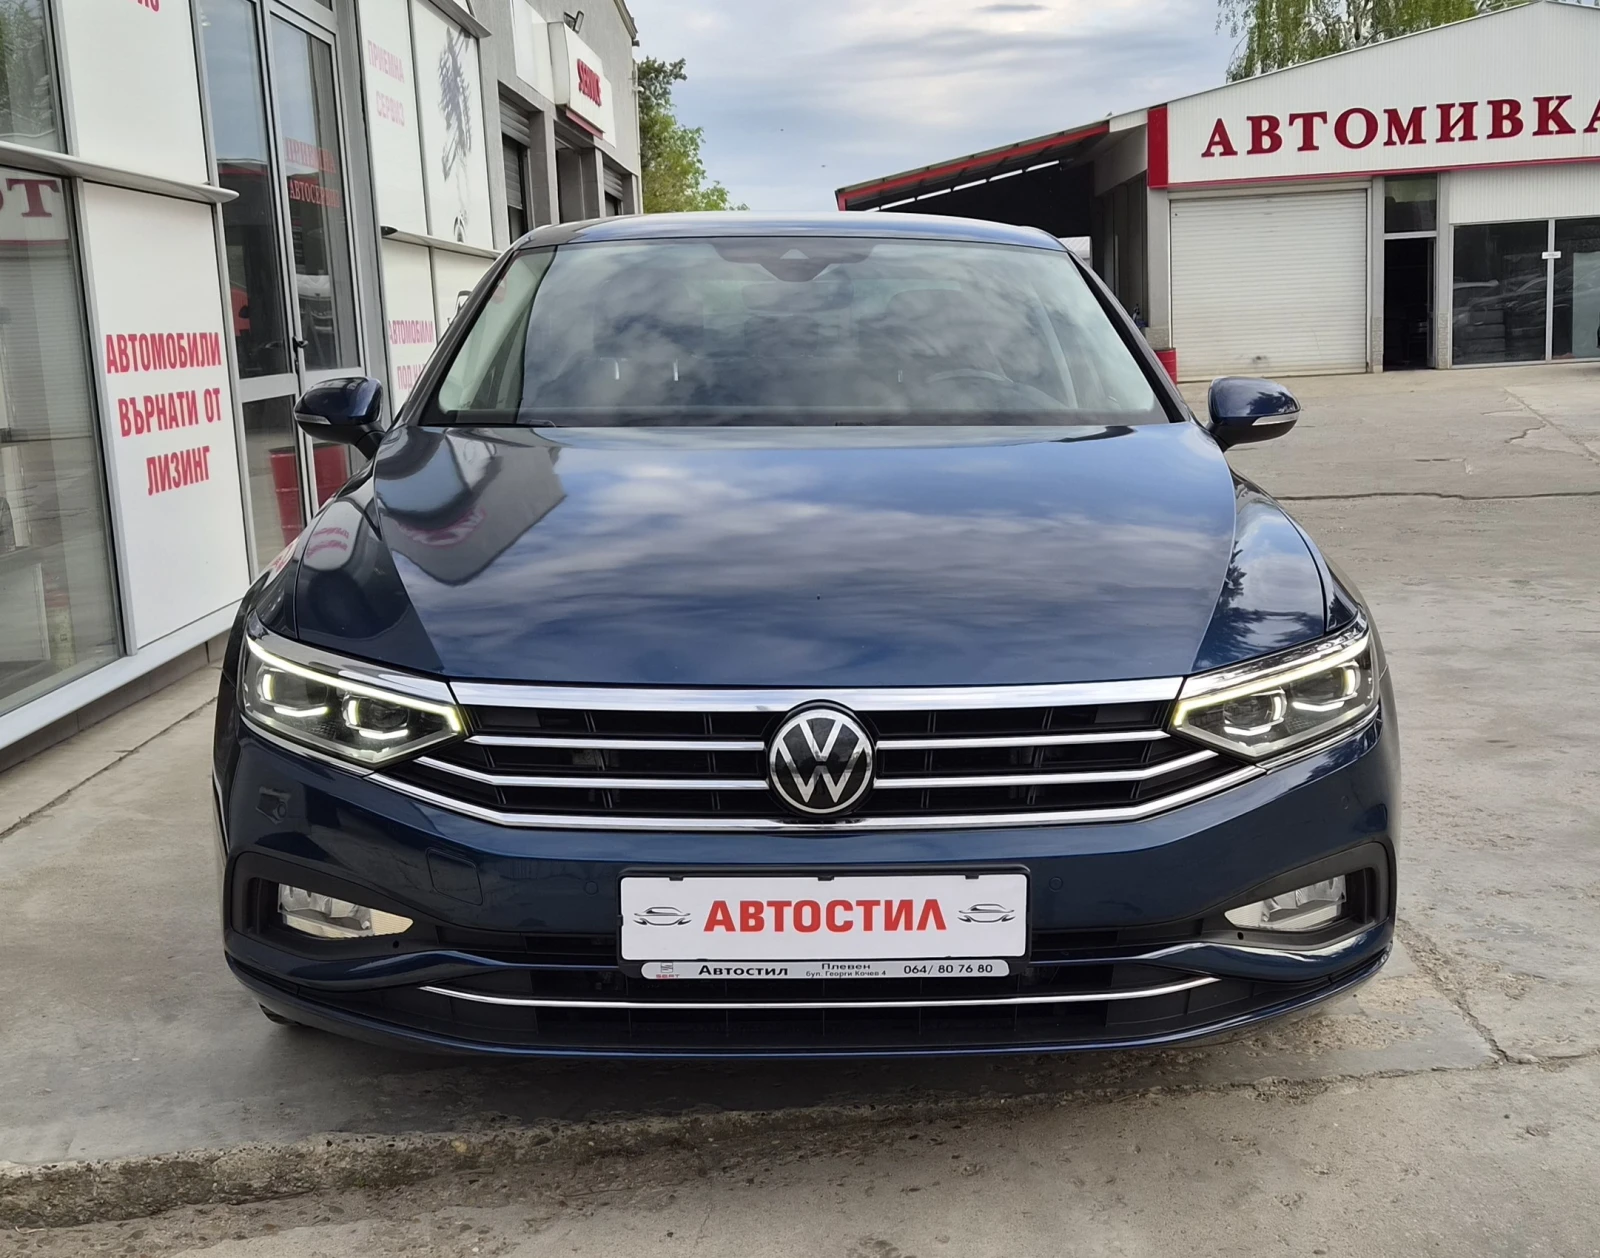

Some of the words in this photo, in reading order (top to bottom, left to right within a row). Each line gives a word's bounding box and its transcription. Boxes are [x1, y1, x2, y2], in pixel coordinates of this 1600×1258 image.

[106, 332, 221, 374] АВТОМОБИЛИ
[117, 390, 199, 437] ВЪРНАТИ
[203, 387, 221, 423] ОТ
[146, 445, 210, 496] ЛИЗИНГ
[703, 899, 947, 933] АВТОСТИЛ
[904, 965, 933, 974] 064/
[938, 964, 953, 973] 80
[958, 964, 973, 973] 76
[977, 964, 993, 973] 80
